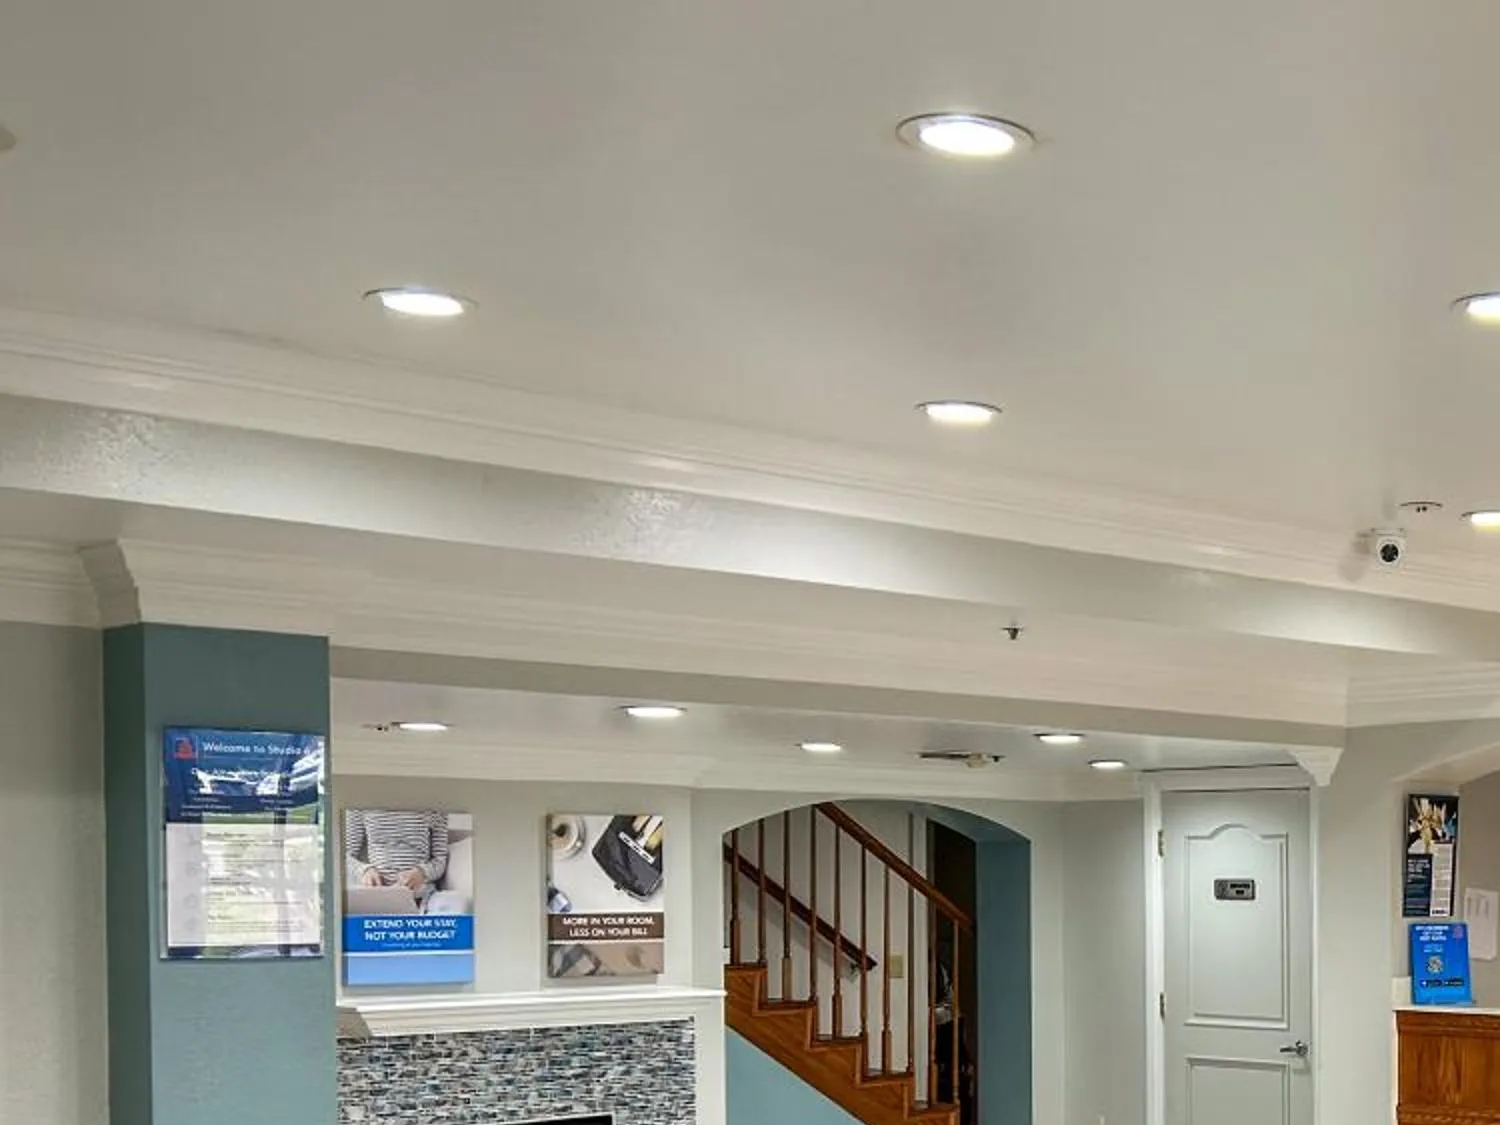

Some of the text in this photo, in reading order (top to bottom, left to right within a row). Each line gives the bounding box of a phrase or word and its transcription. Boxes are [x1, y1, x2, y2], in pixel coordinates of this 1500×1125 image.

[202, 742, 250, 753] Welcome
[253, 745, 266, 754] to
[267, 744, 301, 755] Studio
[363, 919, 403, 929] EXTEND
[406, 919, 432, 928] YOUR
[563, 917, 588, 926] MORE
[590, 917, 600, 925] IN
[602, 917, 625, 925] YOUR
[364, 930, 456, 941] NOT YOUR BUDGET
[569, 928, 589, 937] LESS
[591, 928, 605, 937] ON
[607, 928, 631, 937] YOUR
